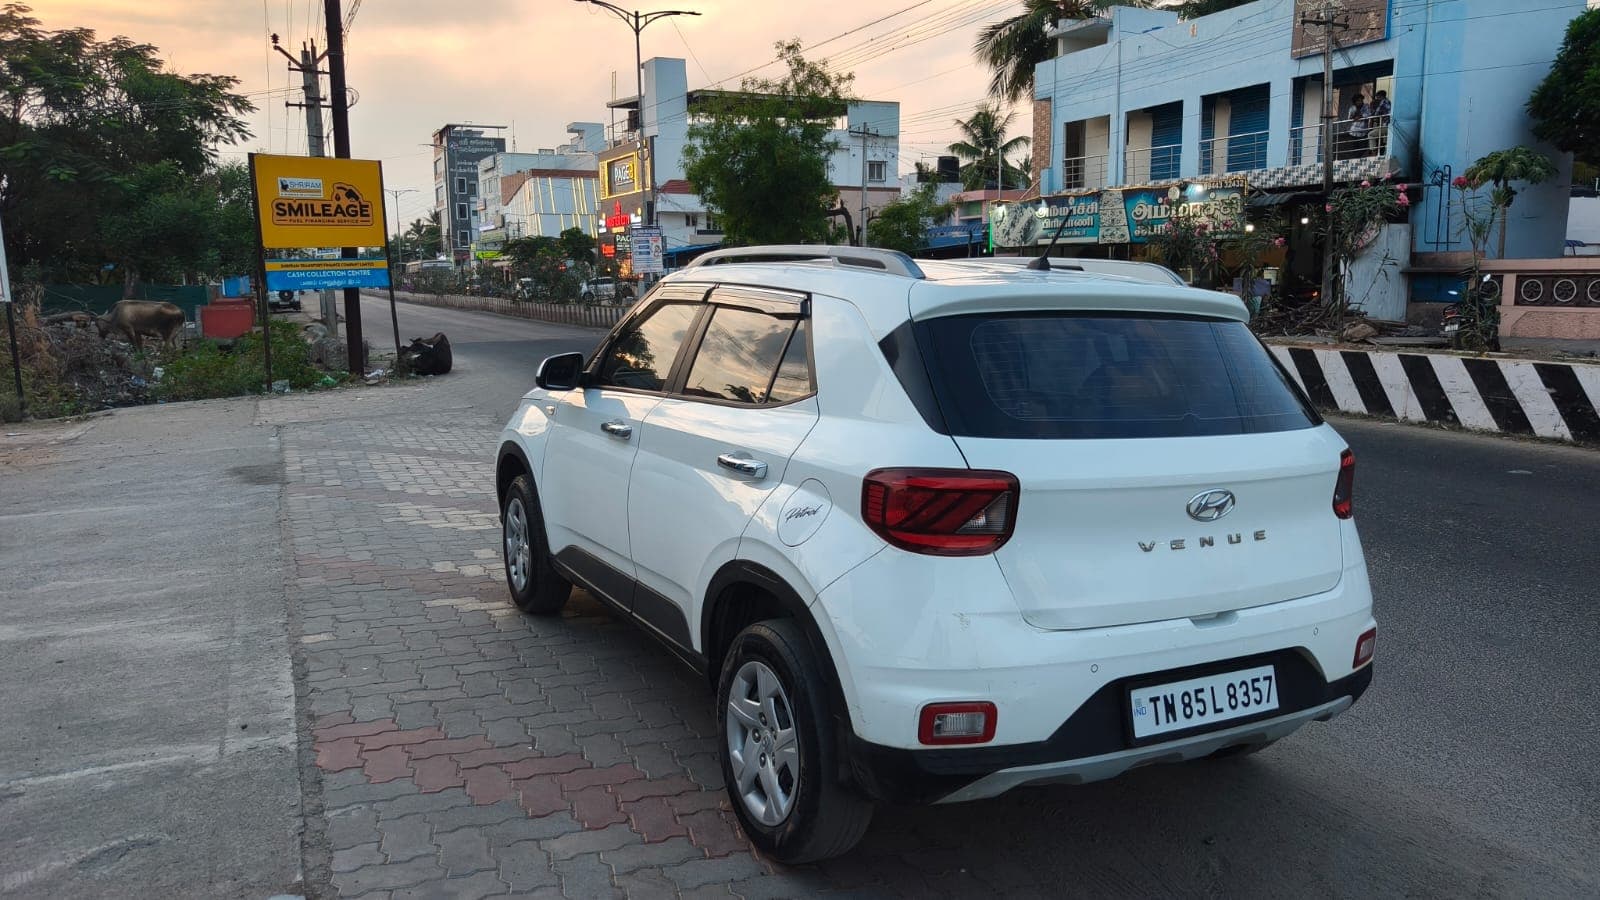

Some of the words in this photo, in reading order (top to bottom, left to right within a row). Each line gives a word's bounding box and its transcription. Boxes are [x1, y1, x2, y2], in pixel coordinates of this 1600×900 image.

[289, 181, 321, 189] SHRIRAM
[275, 202, 370, 217] SMILEAGE
[785, 504, 823, 523] Petrol
[1138, 529, 1266, 553] VENUE
[1149, 693, 1177, 726] TN
[1181, 688, 1207, 719] 85
[1211, 686, 1224, 714] L
[1227, 675, 1273, 710] 8357
[1134, 707, 1147, 717] IND
